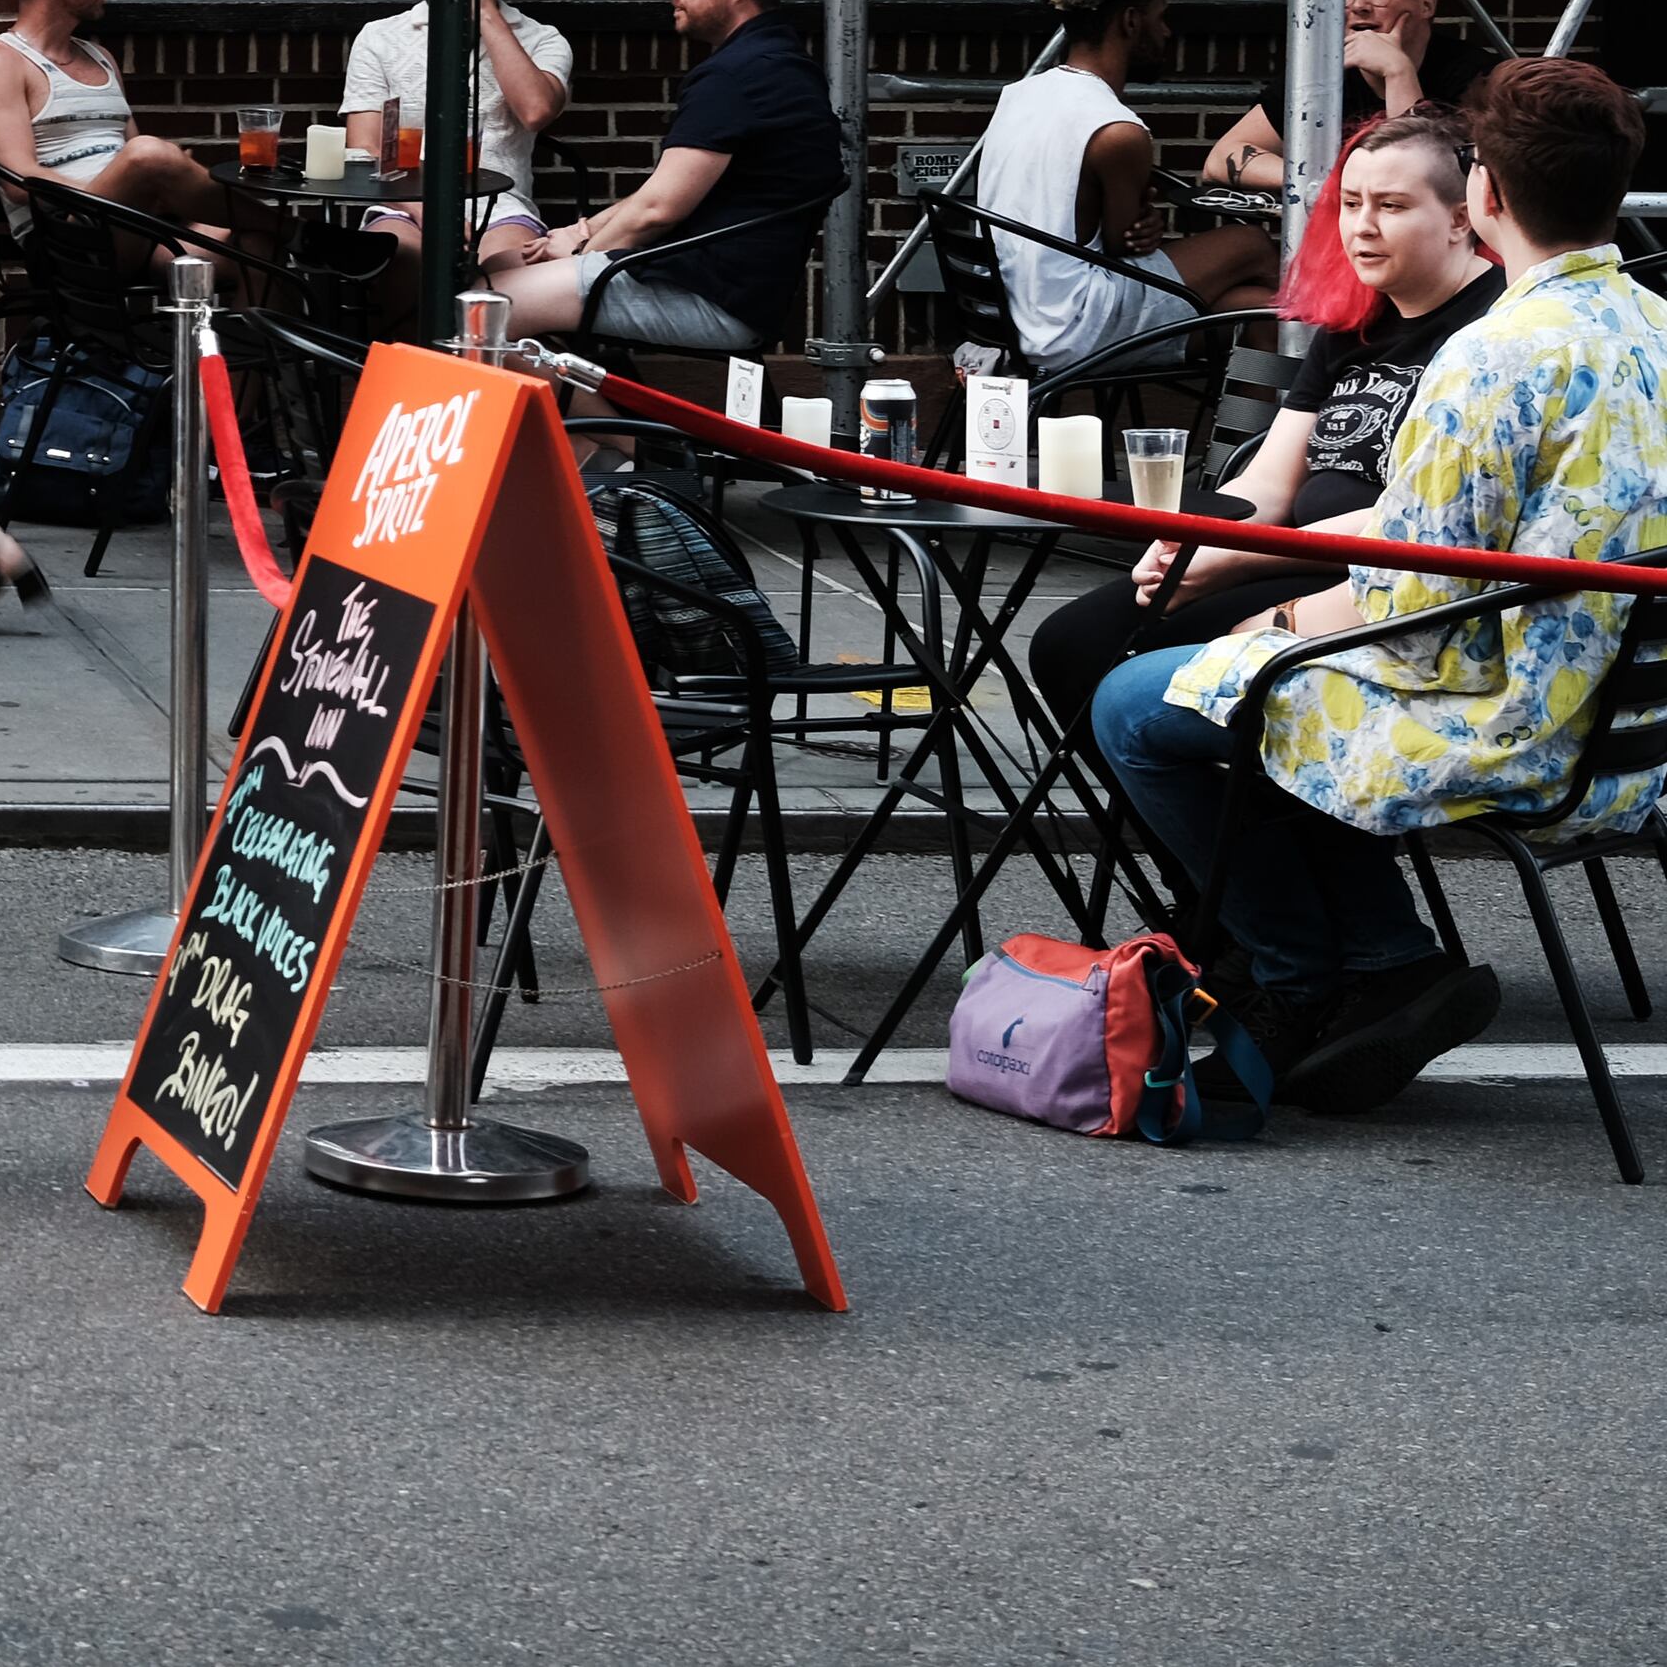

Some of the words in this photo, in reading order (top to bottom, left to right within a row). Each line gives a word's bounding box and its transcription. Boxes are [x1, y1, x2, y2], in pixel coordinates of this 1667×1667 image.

[915, 155, 961, 166] ROME
[352, 391, 475, 502] APEROL
[337, 582, 379, 644] THE
[281, 609, 389, 718] STONEWALL
[305, 703, 347, 750] INN
[232, 805, 335, 904] CELEBRATING
[200, 864, 265, 942] BLACK
[255, 906, 315, 994] VOICES
[191, 956, 253, 1048] DRAG
[155, 1031, 259, 1152] BINGO!
[977, 1050, 1031, 1076] cotopaxi
